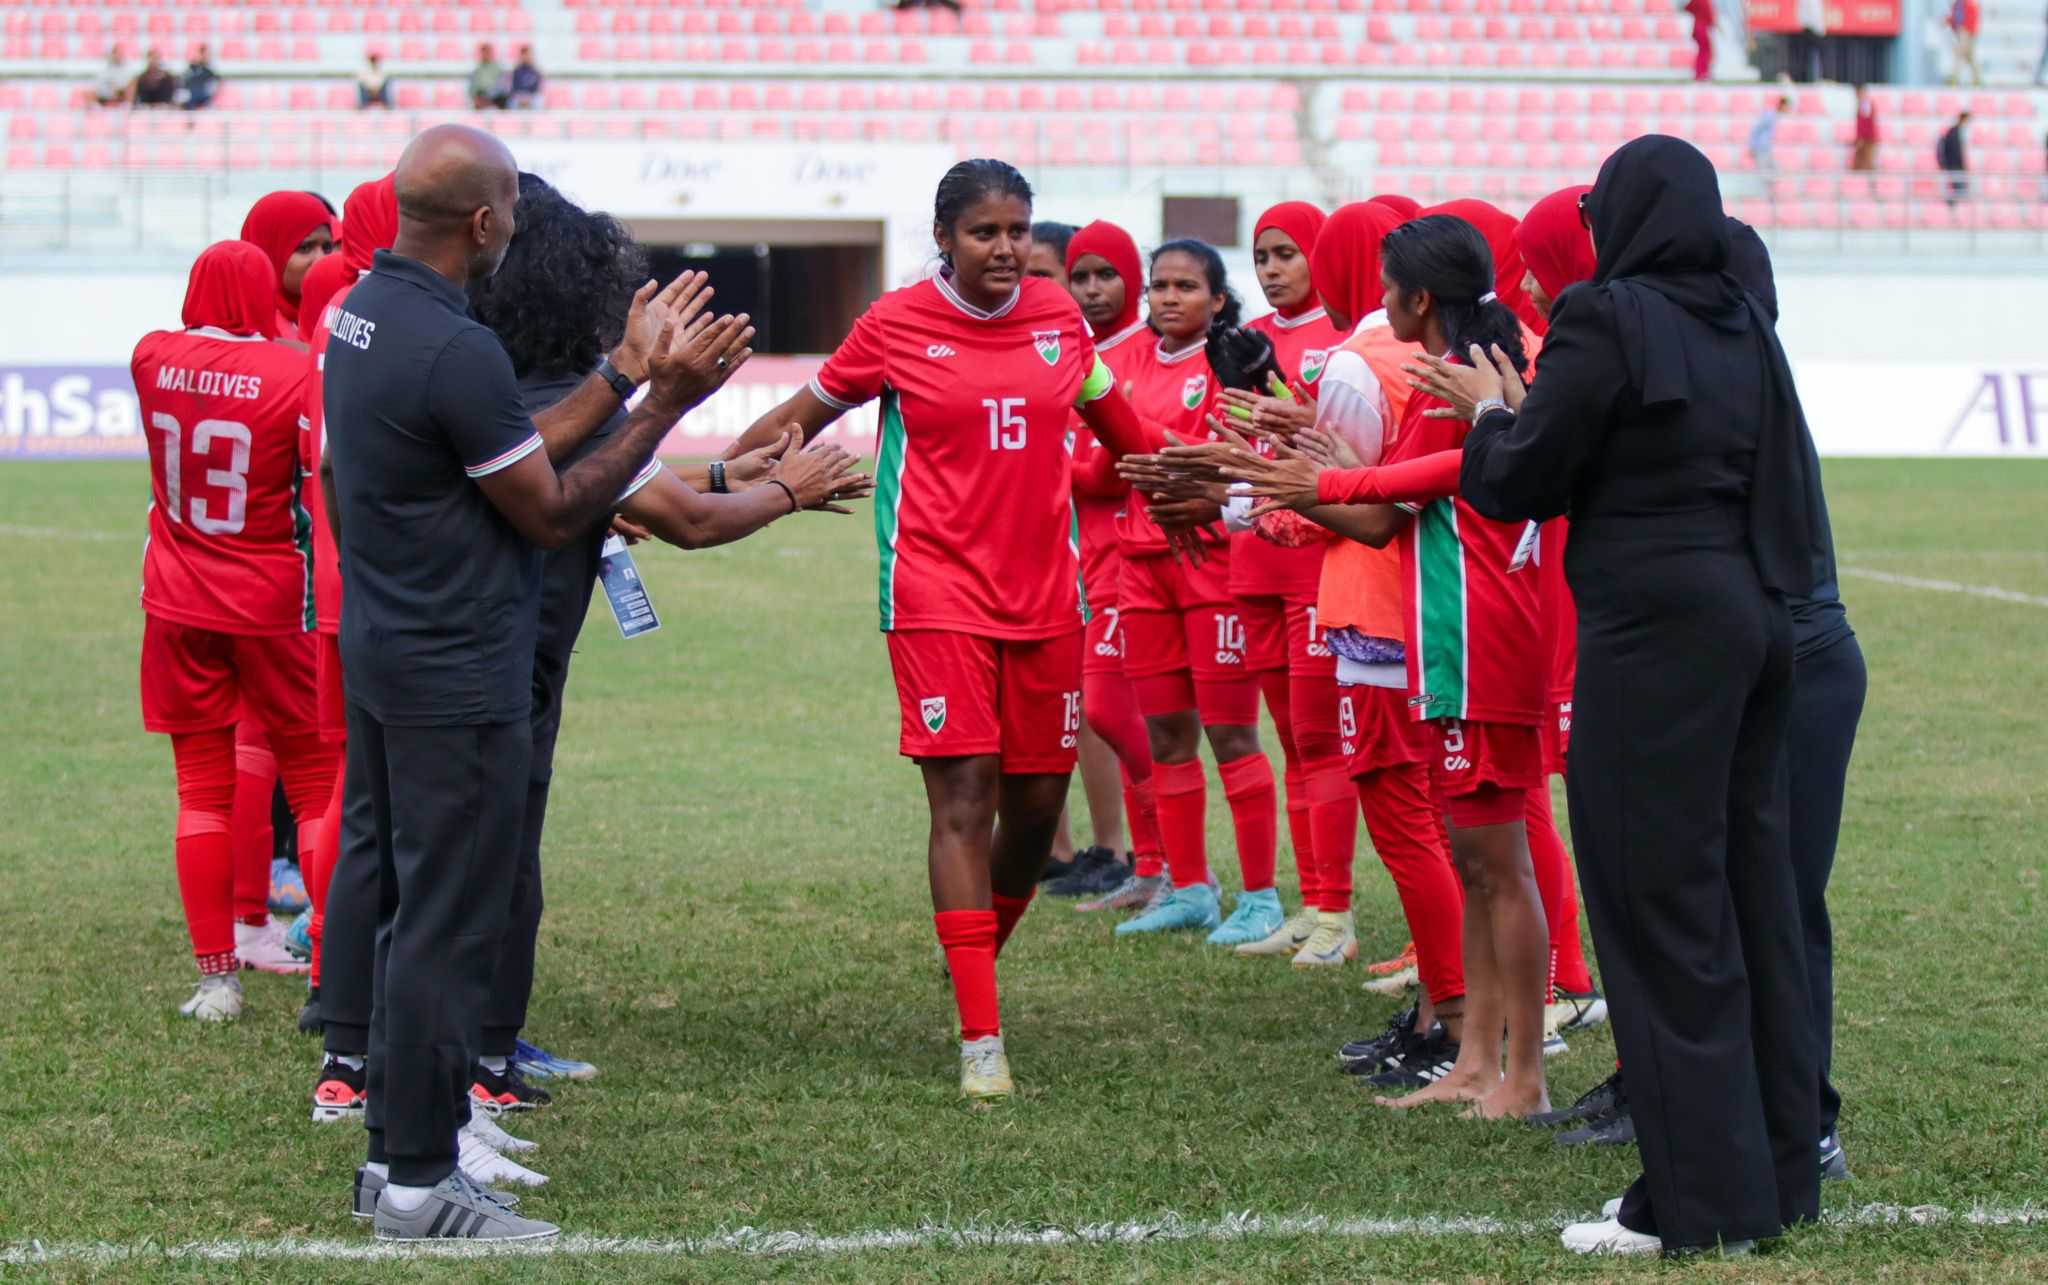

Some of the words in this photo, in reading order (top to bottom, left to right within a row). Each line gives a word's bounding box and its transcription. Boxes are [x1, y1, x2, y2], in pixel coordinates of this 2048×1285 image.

[156, 365, 262, 400] MALDIVES
[982, 397, 1027, 450] 15
[152, 411, 252, 535] 13
[1103, 607, 1120, 642] 7
[1214, 614, 1243, 650] 10
[1062, 690, 1081, 732] 15
